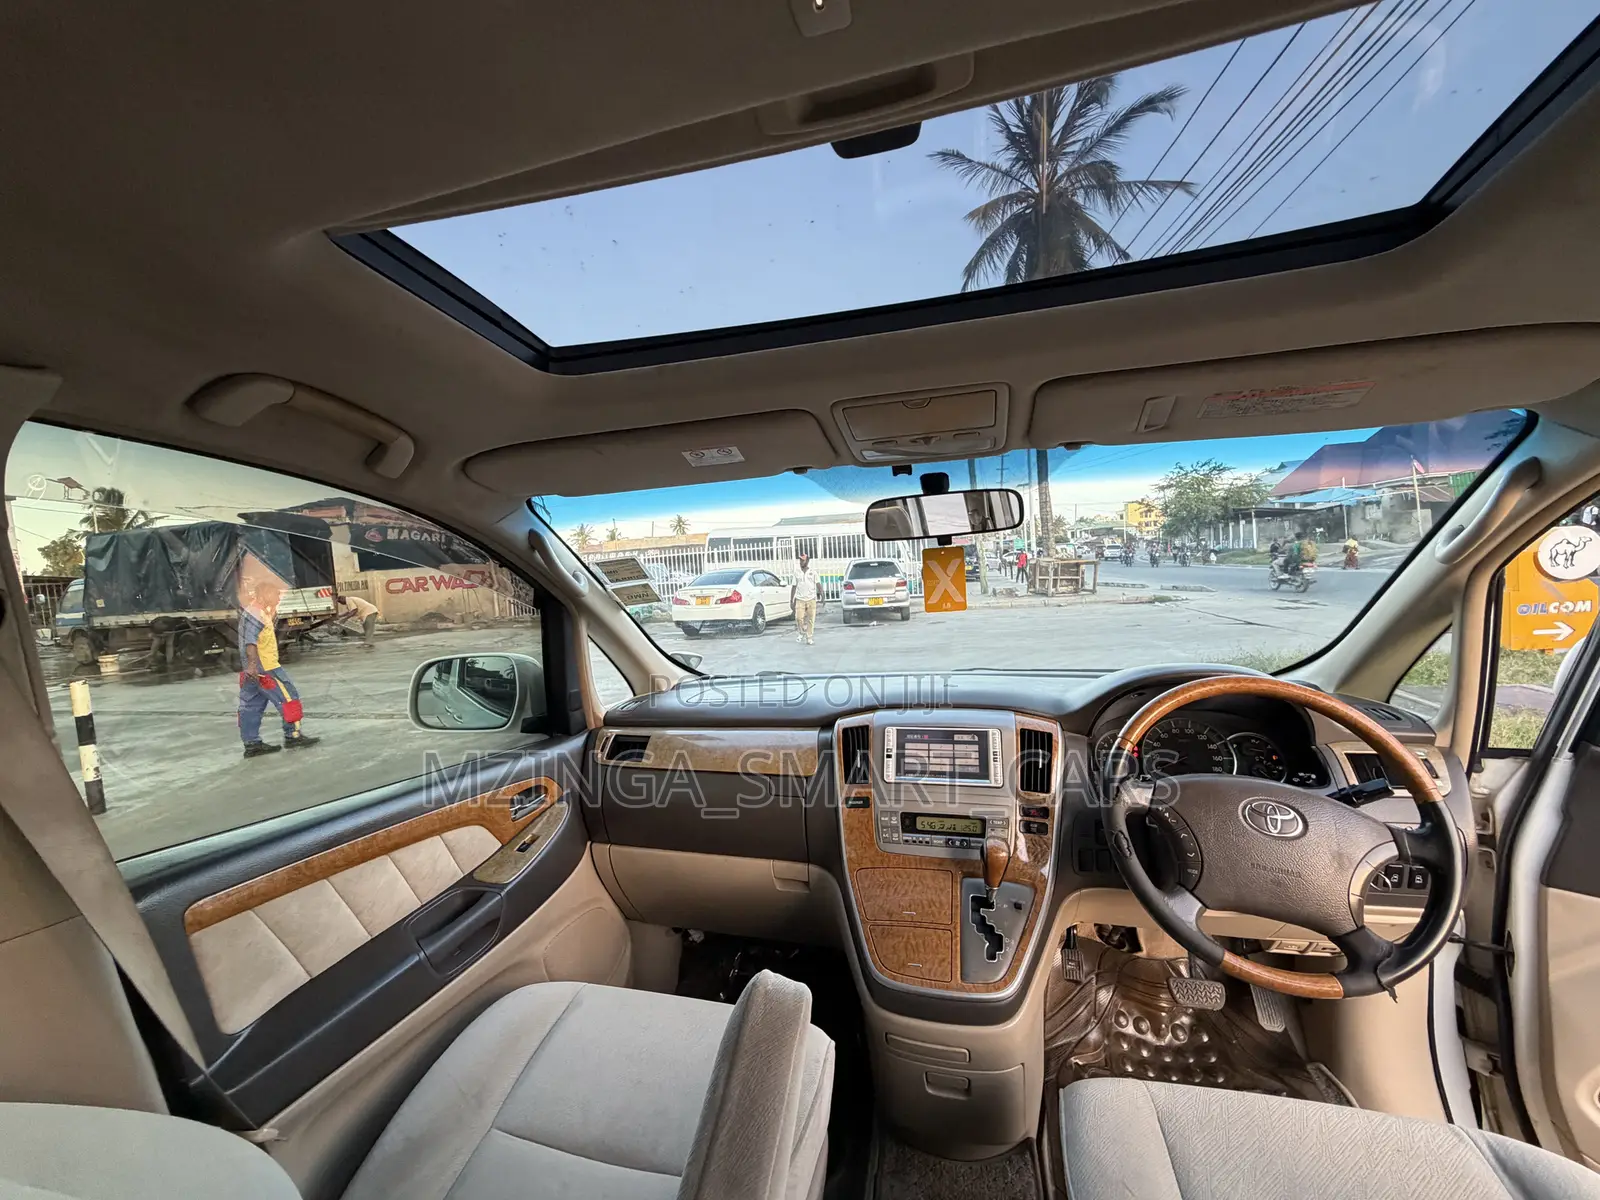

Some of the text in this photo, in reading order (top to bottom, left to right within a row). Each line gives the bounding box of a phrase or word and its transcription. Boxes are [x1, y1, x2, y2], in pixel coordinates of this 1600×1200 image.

[386, 528, 446, 543] MAGARI
[385, 576, 429, 595] CAR
[1516, 599, 1593, 616] OILCOM
